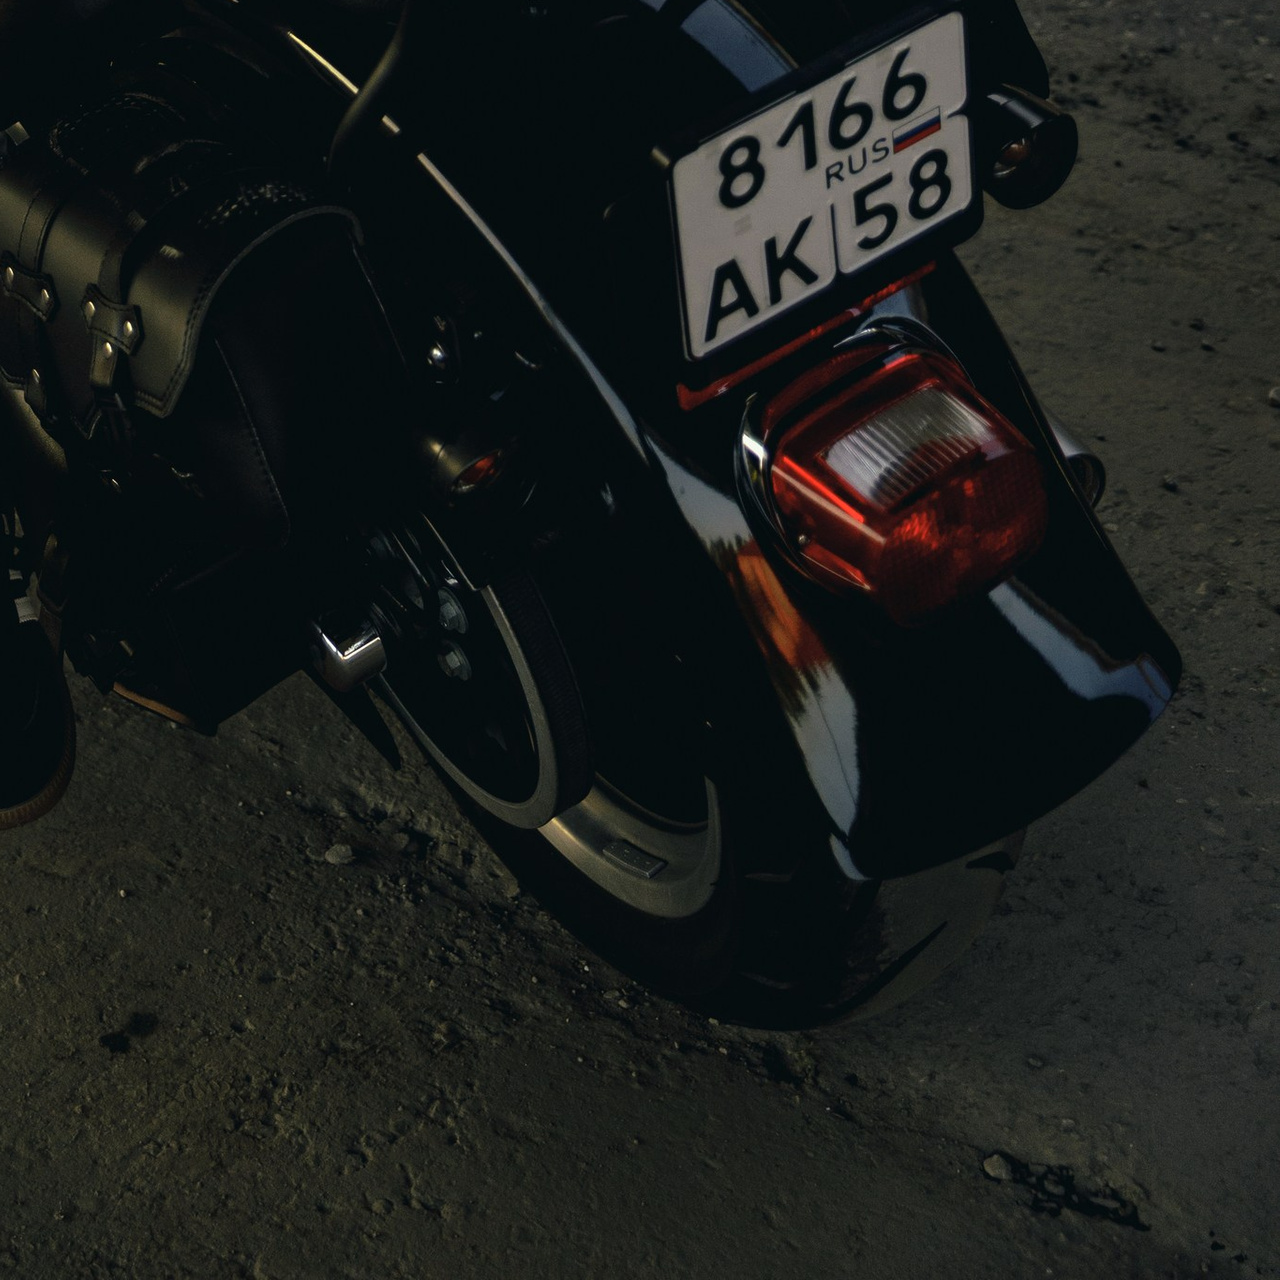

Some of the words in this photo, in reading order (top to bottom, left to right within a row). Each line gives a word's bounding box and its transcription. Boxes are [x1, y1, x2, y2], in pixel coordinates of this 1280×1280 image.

[719, 47, 928, 209] 8166
[825, 137, 890, 189] RUS
[704, 215, 819, 343] AK
[853, 148, 952, 251] 58
